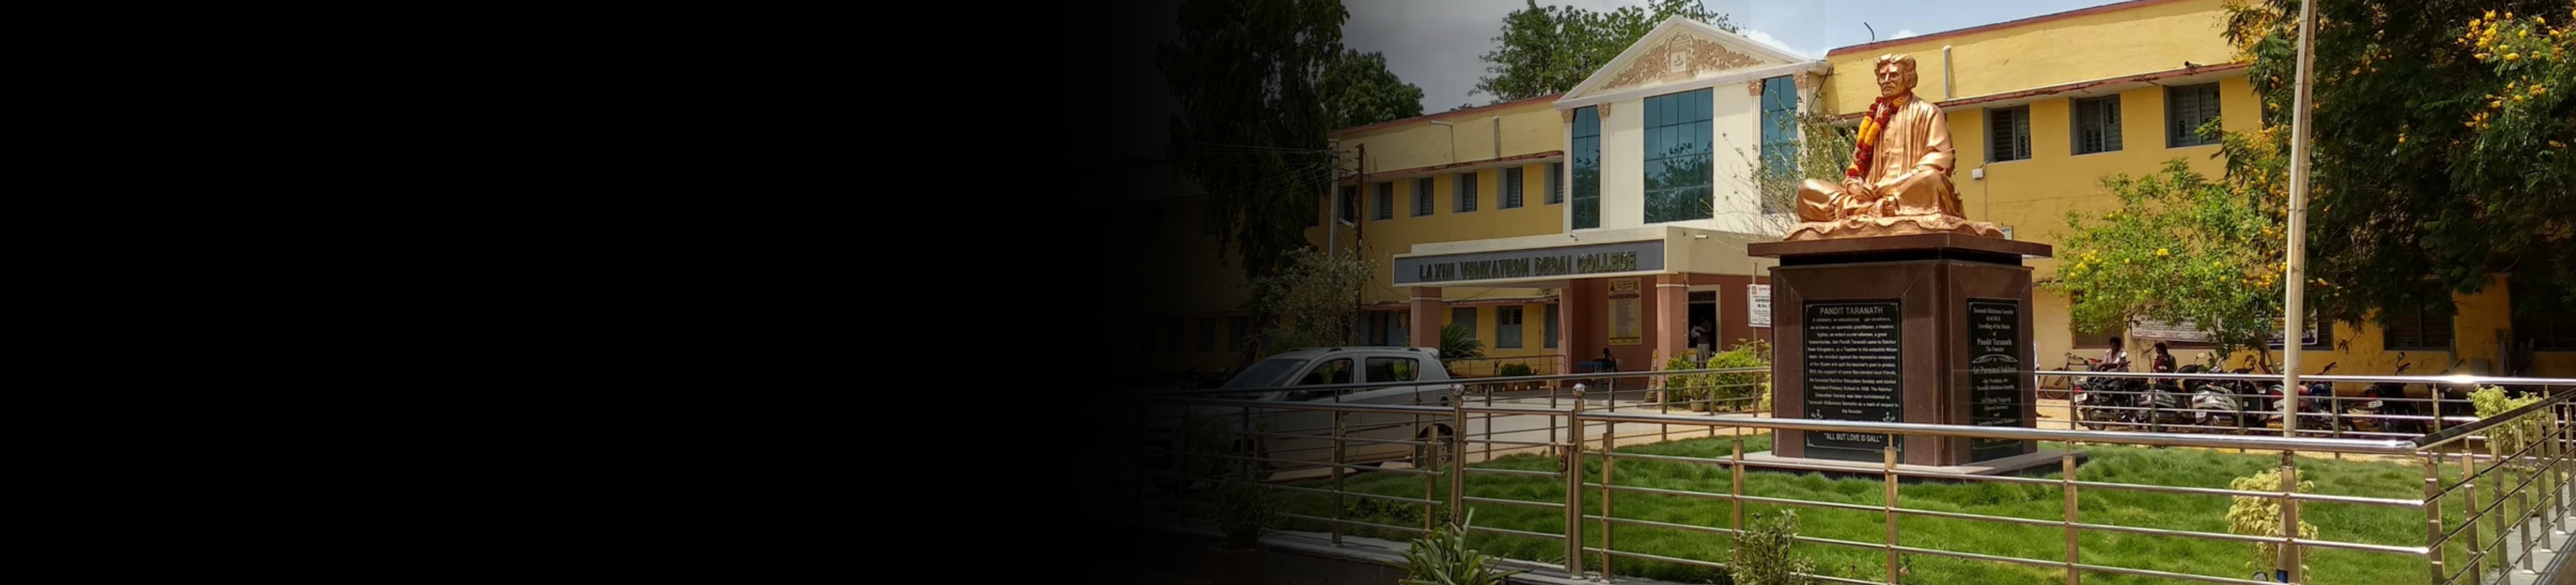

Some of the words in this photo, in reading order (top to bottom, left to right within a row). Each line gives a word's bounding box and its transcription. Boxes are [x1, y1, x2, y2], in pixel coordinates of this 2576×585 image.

[1460, 258, 1529, 280] VENKATESH
[1535, 255, 1572, 275] DESAI
[1577, 251, 1637, 274] COLLEGE
